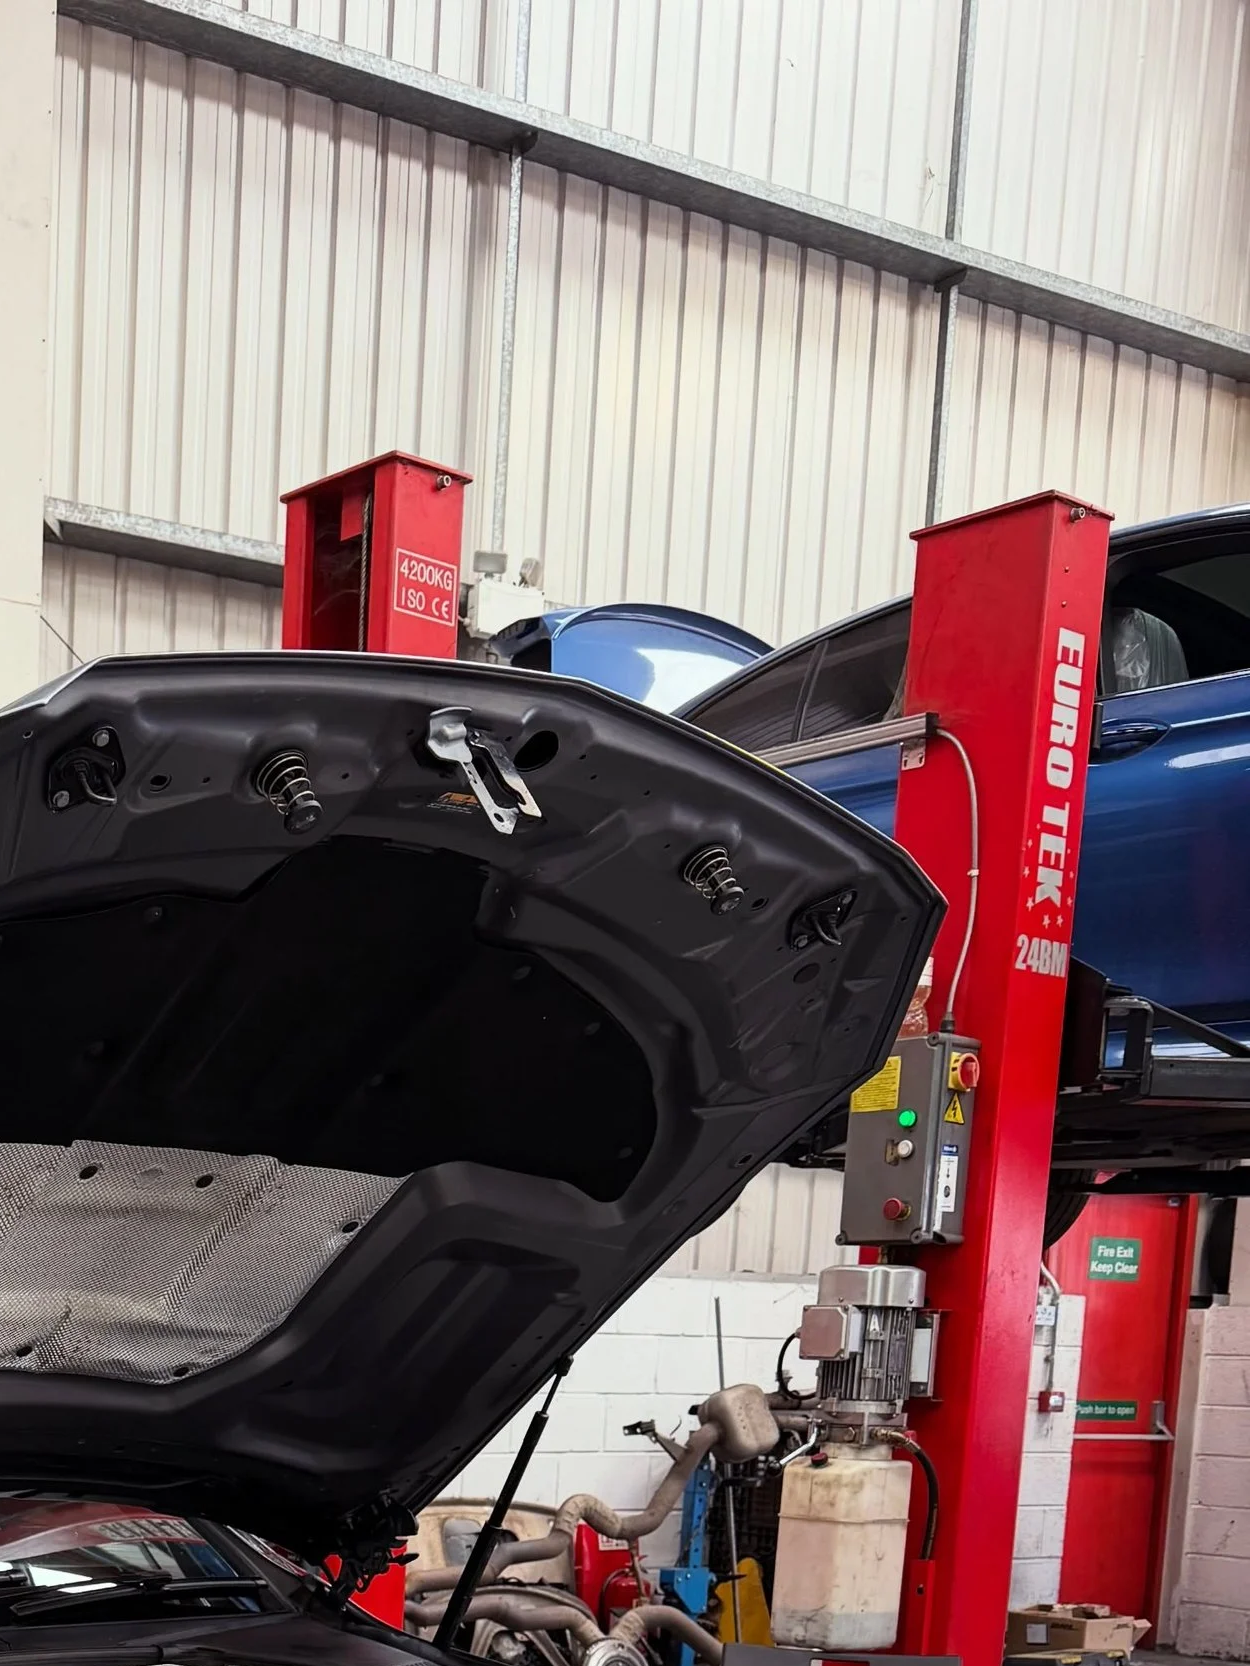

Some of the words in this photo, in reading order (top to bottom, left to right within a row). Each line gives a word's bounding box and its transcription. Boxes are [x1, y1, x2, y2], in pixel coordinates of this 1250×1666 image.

[399, 558, 453, 592] 4200KG
[401, 586, 426, 612] ISO
[1046, 626, 1086, 790] EURO
[1034, 801, 1070, 908] TEK
[1014, 933, 1069, 978] 24BM
[1090, 1260, 1113, 1275] Keep
[1115, 1261, 1139, 1274] Clear
[1097, 1245, 1115, 1257] Fire
[1116, 1246, 1134, 1258] Exit
